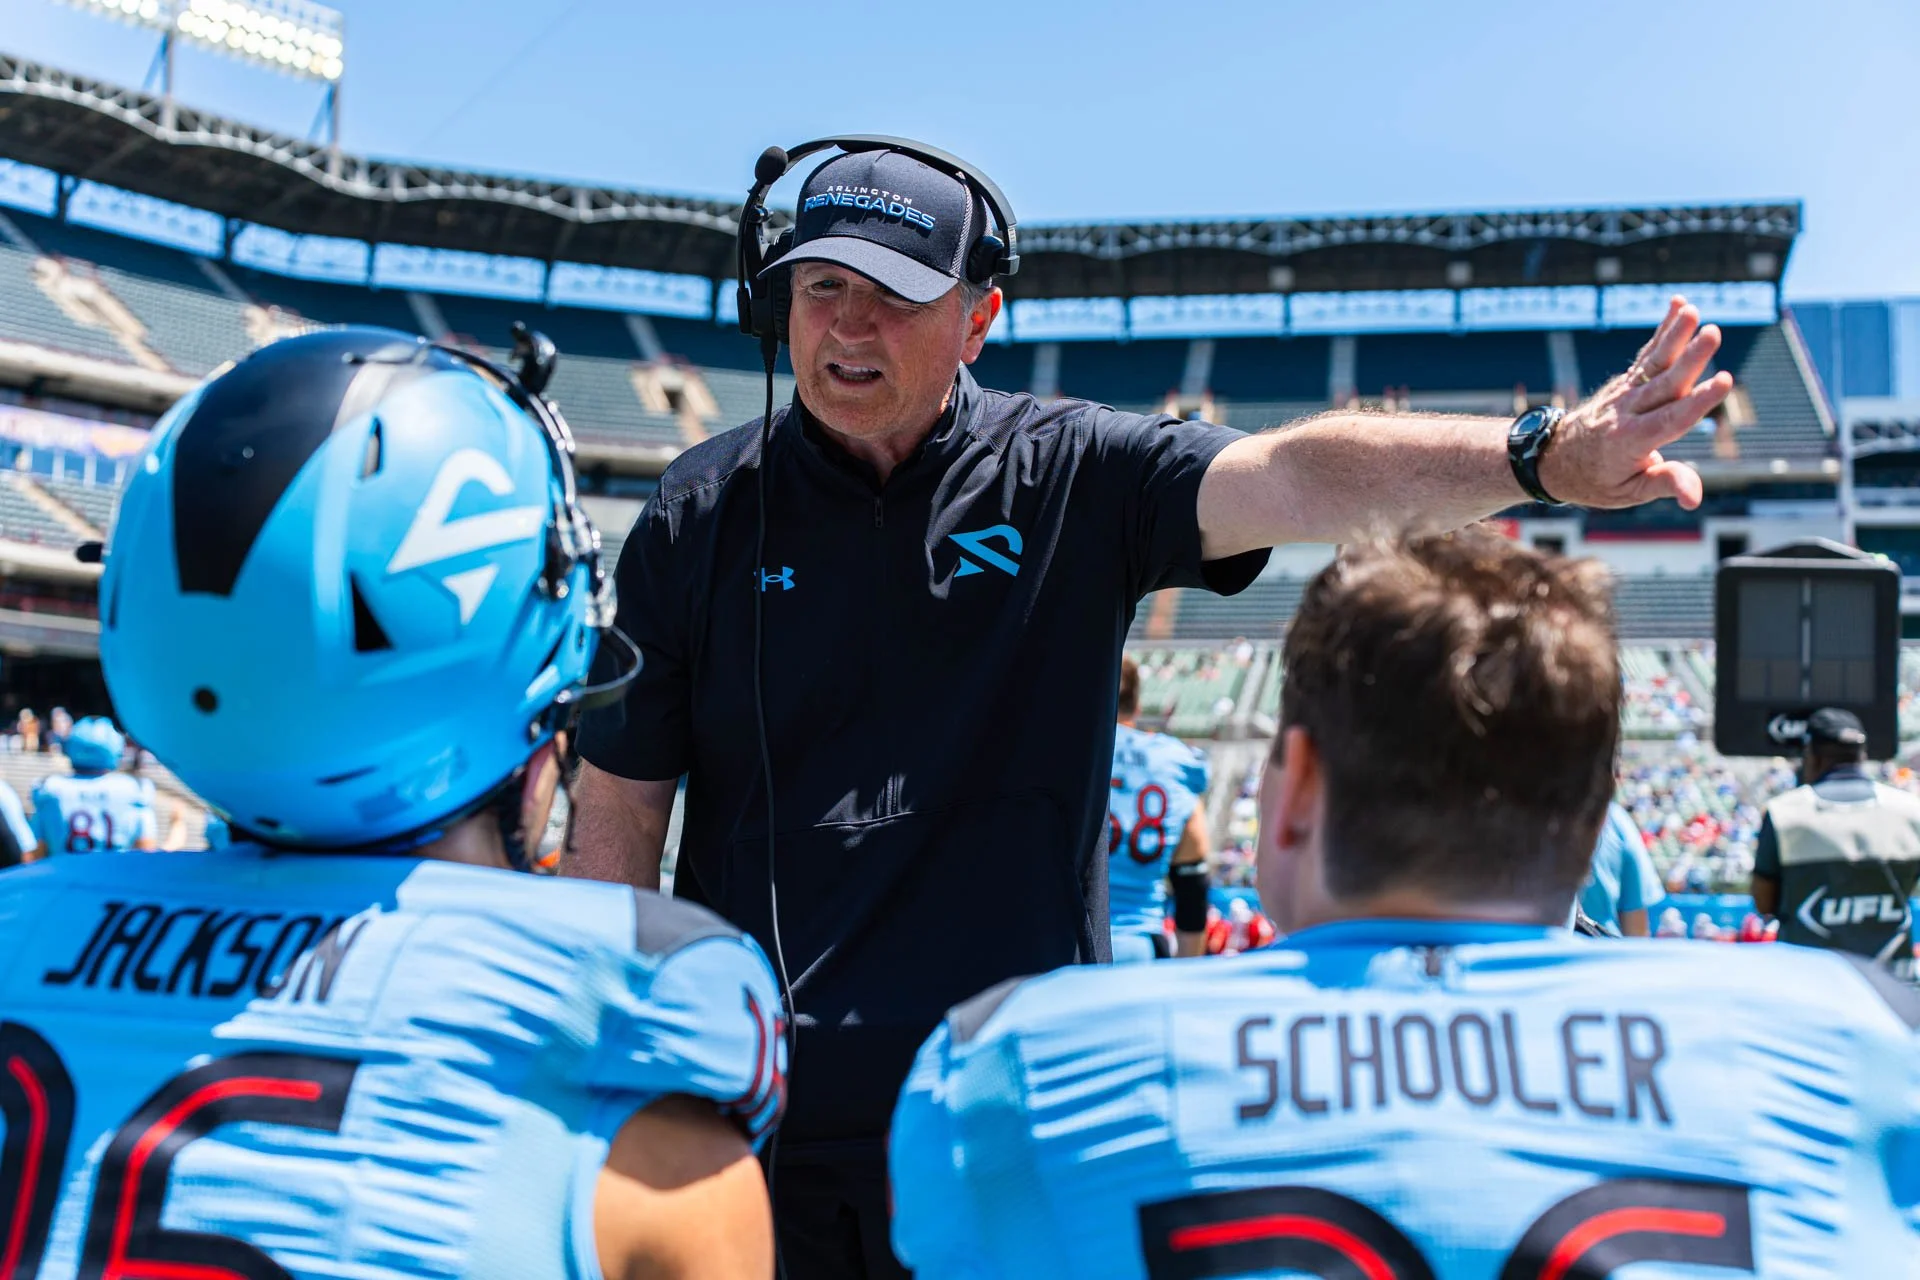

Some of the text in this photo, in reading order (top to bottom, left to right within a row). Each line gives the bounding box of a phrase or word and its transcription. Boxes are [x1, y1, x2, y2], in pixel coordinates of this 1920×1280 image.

[803, 192, 936, 231] RENEGADES
[827, 185, 913, 205] ARLINGTON
[66, 810, 113, 852] 81
[1821, 894, 1904, 926] UFL
[41, 902, 370, 1003] JACKSON
[1234, 1008, 1675, 1125] SCHOOLER
